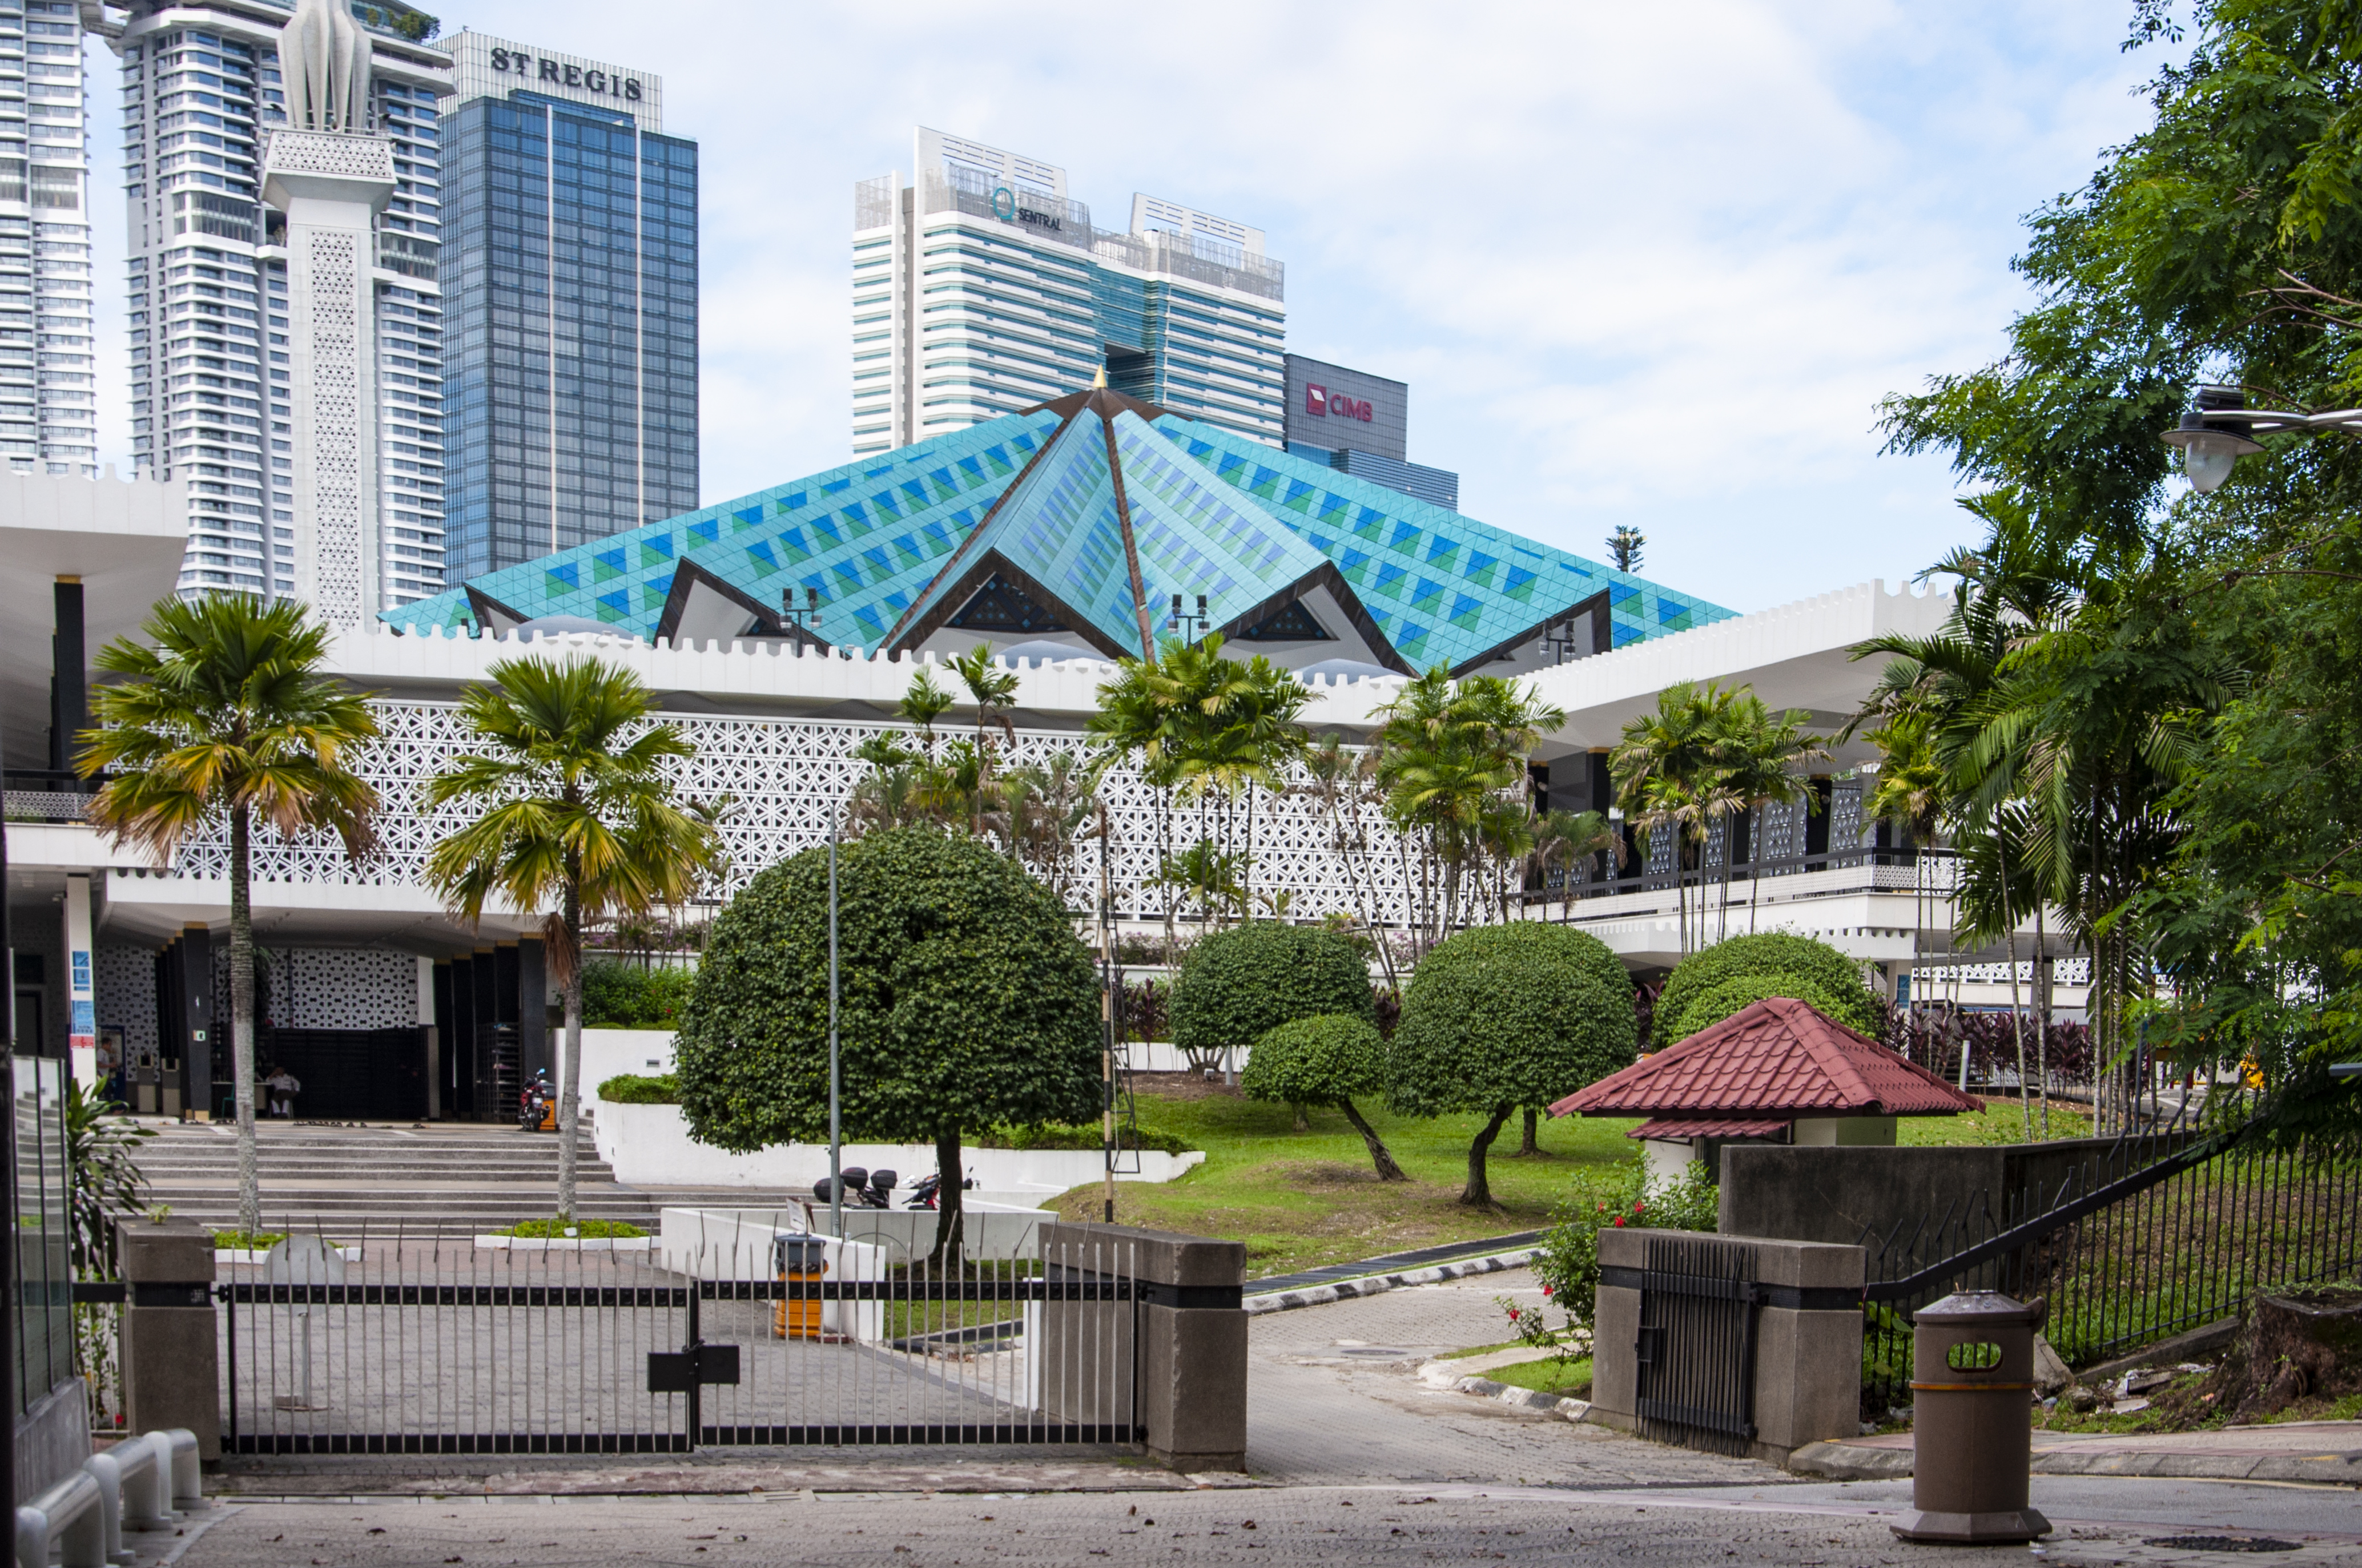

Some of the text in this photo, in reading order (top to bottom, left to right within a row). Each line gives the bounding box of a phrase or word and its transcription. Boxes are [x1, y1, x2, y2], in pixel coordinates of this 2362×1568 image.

[539, 58, 641, 100] REGIS
[1019, 208, 1062, 231] SENTRAL
[1331, 394, 1373, 422] CIMB
